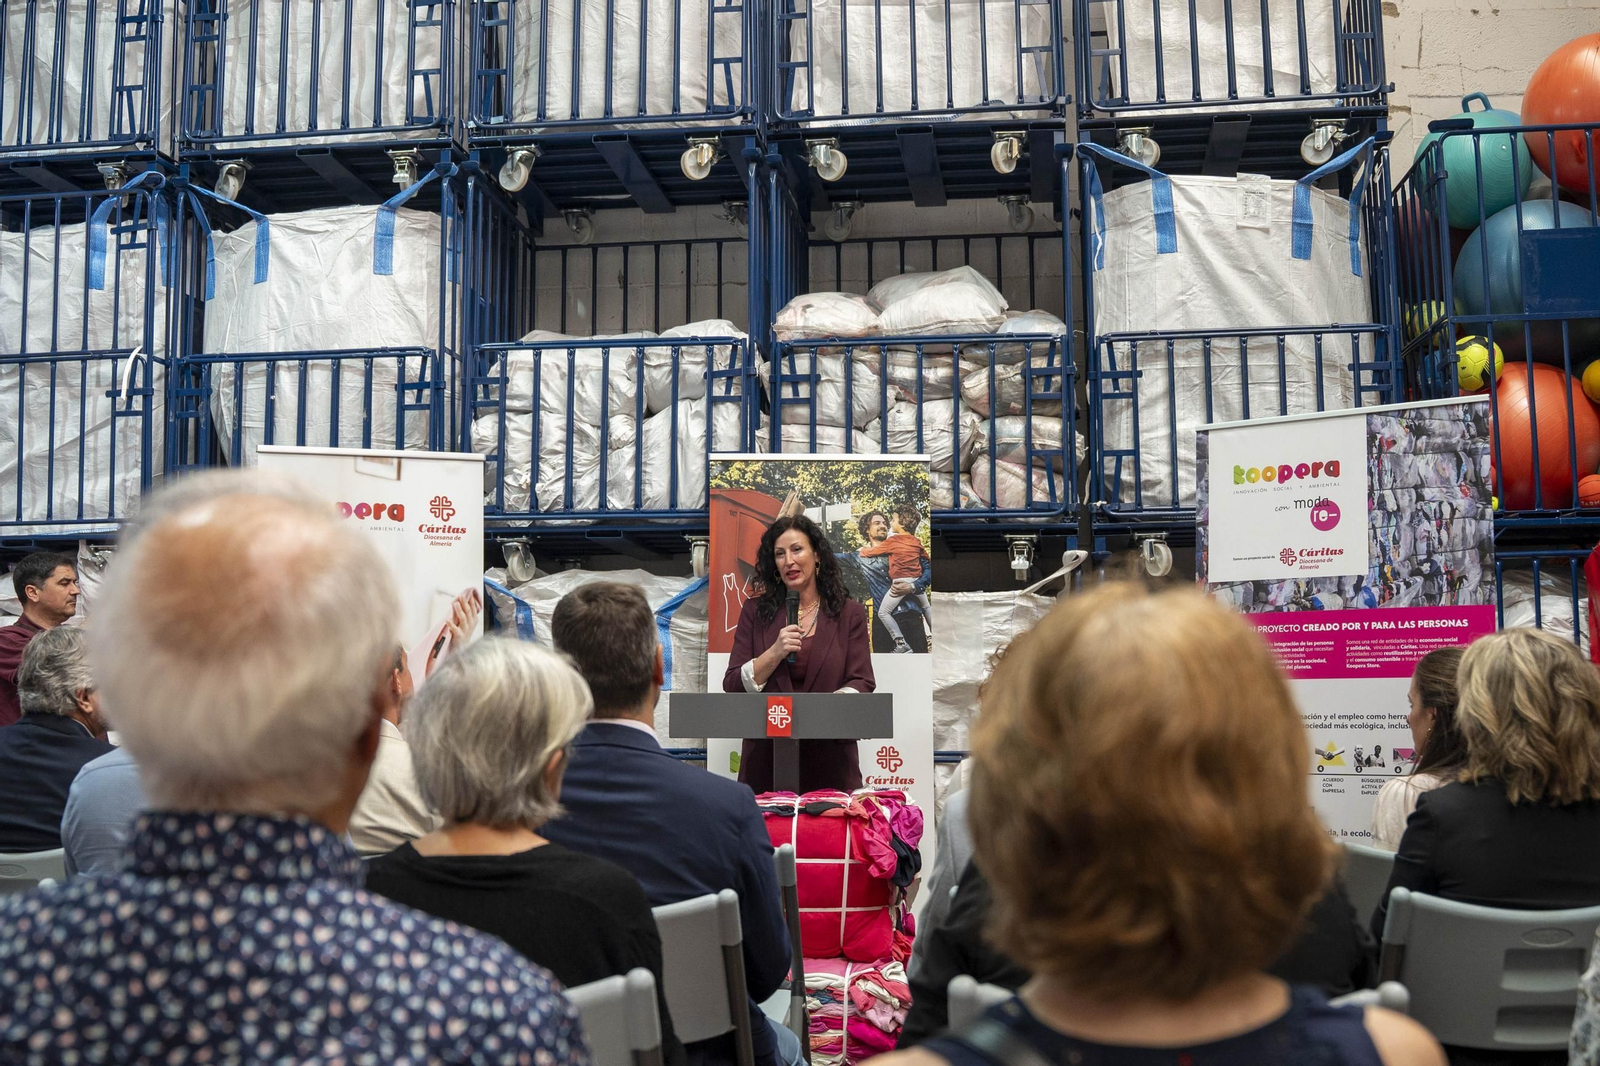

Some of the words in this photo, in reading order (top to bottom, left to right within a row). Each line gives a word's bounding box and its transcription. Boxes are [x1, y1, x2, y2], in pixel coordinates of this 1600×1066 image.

[1233, 460, 1340, 485] koopera
[1294, 496, 1330, 509] moda
[418, 524, 466, 534] Cáritas
[1299, 548, 1344, 557] Cáritas
[1302, 624, 1339, 632] CREADO
[1342, 622, 1361, 630] POR
[1372, 621, 1396, 629] PARA
[1398, 620, 1416, 628] LAS
[1418, 619, 1468, 628] PERSONAS
[1338, 713, 1364, 721] empleo
[1350, 722, 1386, 730] ecológica,
[866, 775, 914, 784] Cáritas
